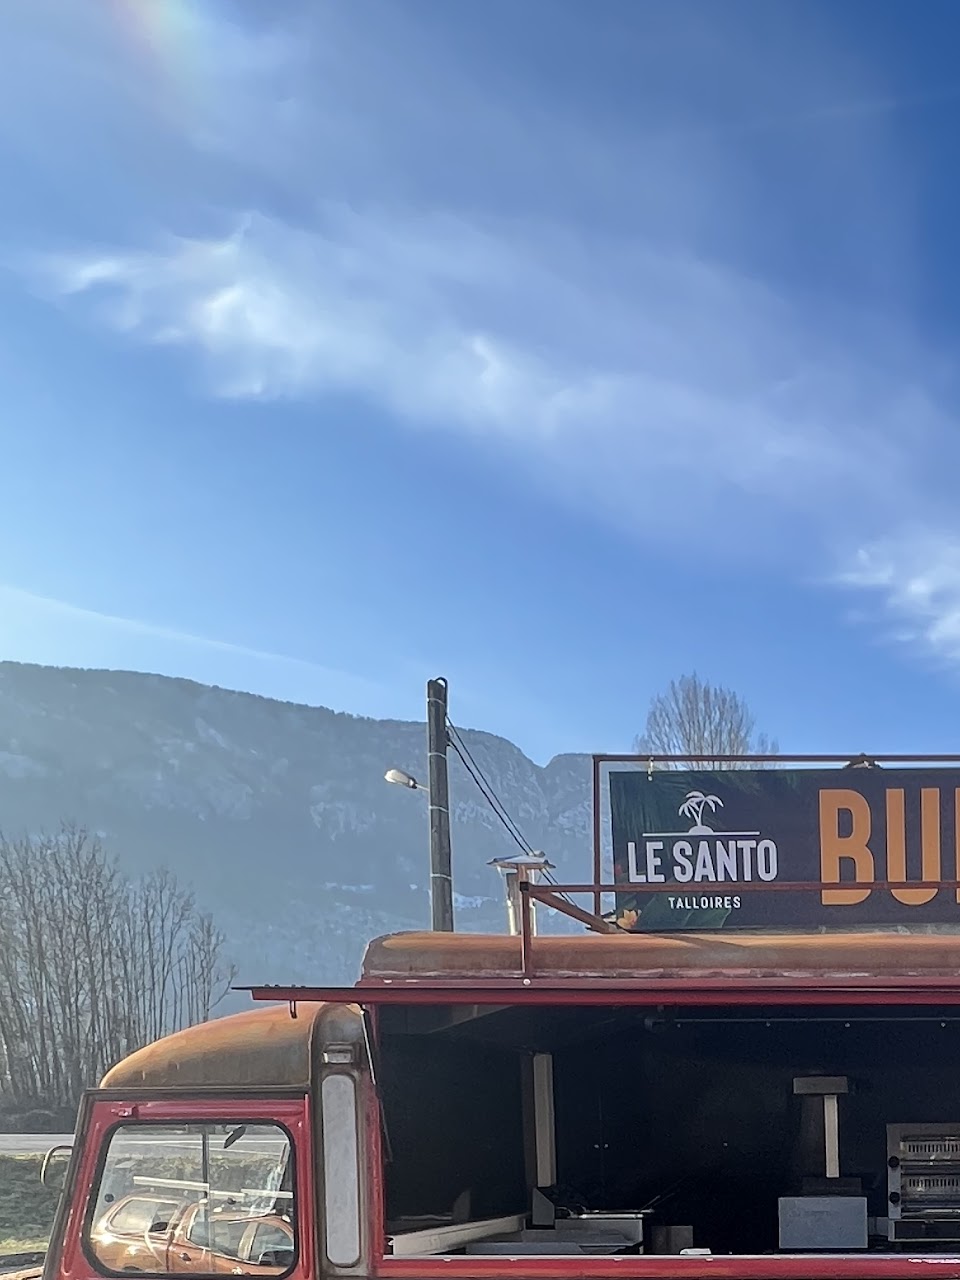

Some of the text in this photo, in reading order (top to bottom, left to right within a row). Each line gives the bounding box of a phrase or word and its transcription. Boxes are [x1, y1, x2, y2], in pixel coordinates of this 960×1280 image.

[627, 839, 778, 883] LE SANTO
[667, 896, 742, 910] TALLOIRES
